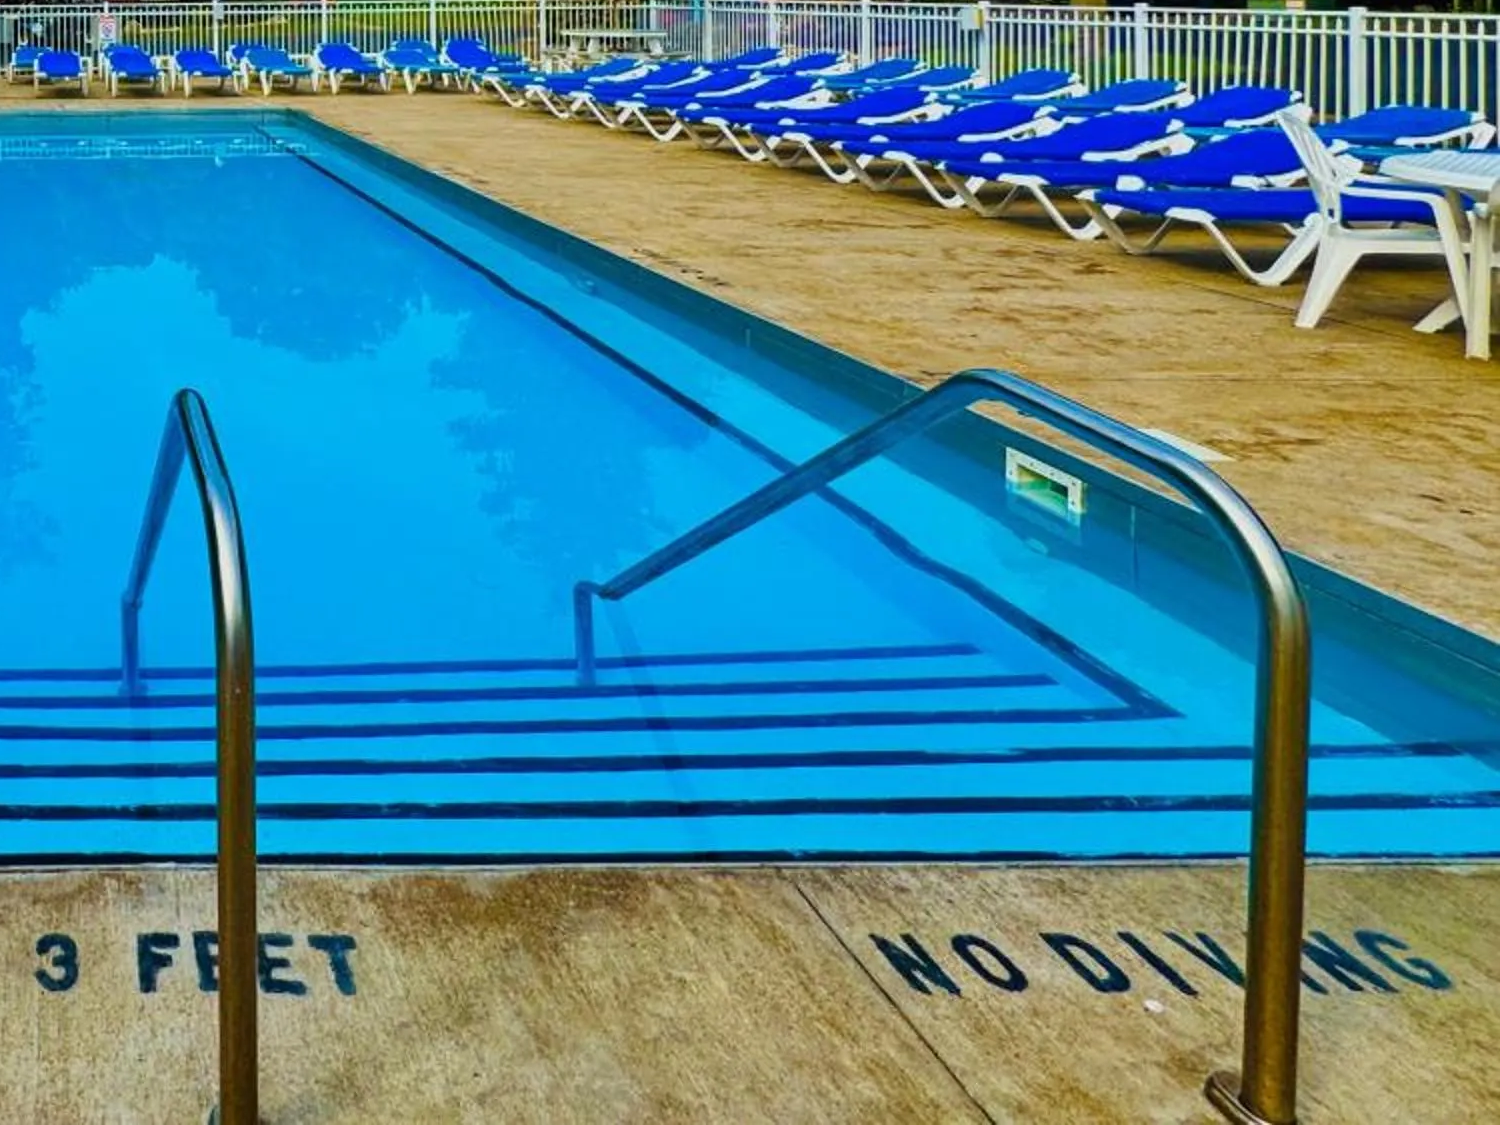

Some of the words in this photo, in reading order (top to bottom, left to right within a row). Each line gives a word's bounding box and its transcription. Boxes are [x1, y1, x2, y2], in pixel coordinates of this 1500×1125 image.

[34, 933, 79, 992] 3
[137, 930, 357, 996] FEET
[869, 931, 1029, 997] NO
[1038, 929, 1453, 997] DIVNG
